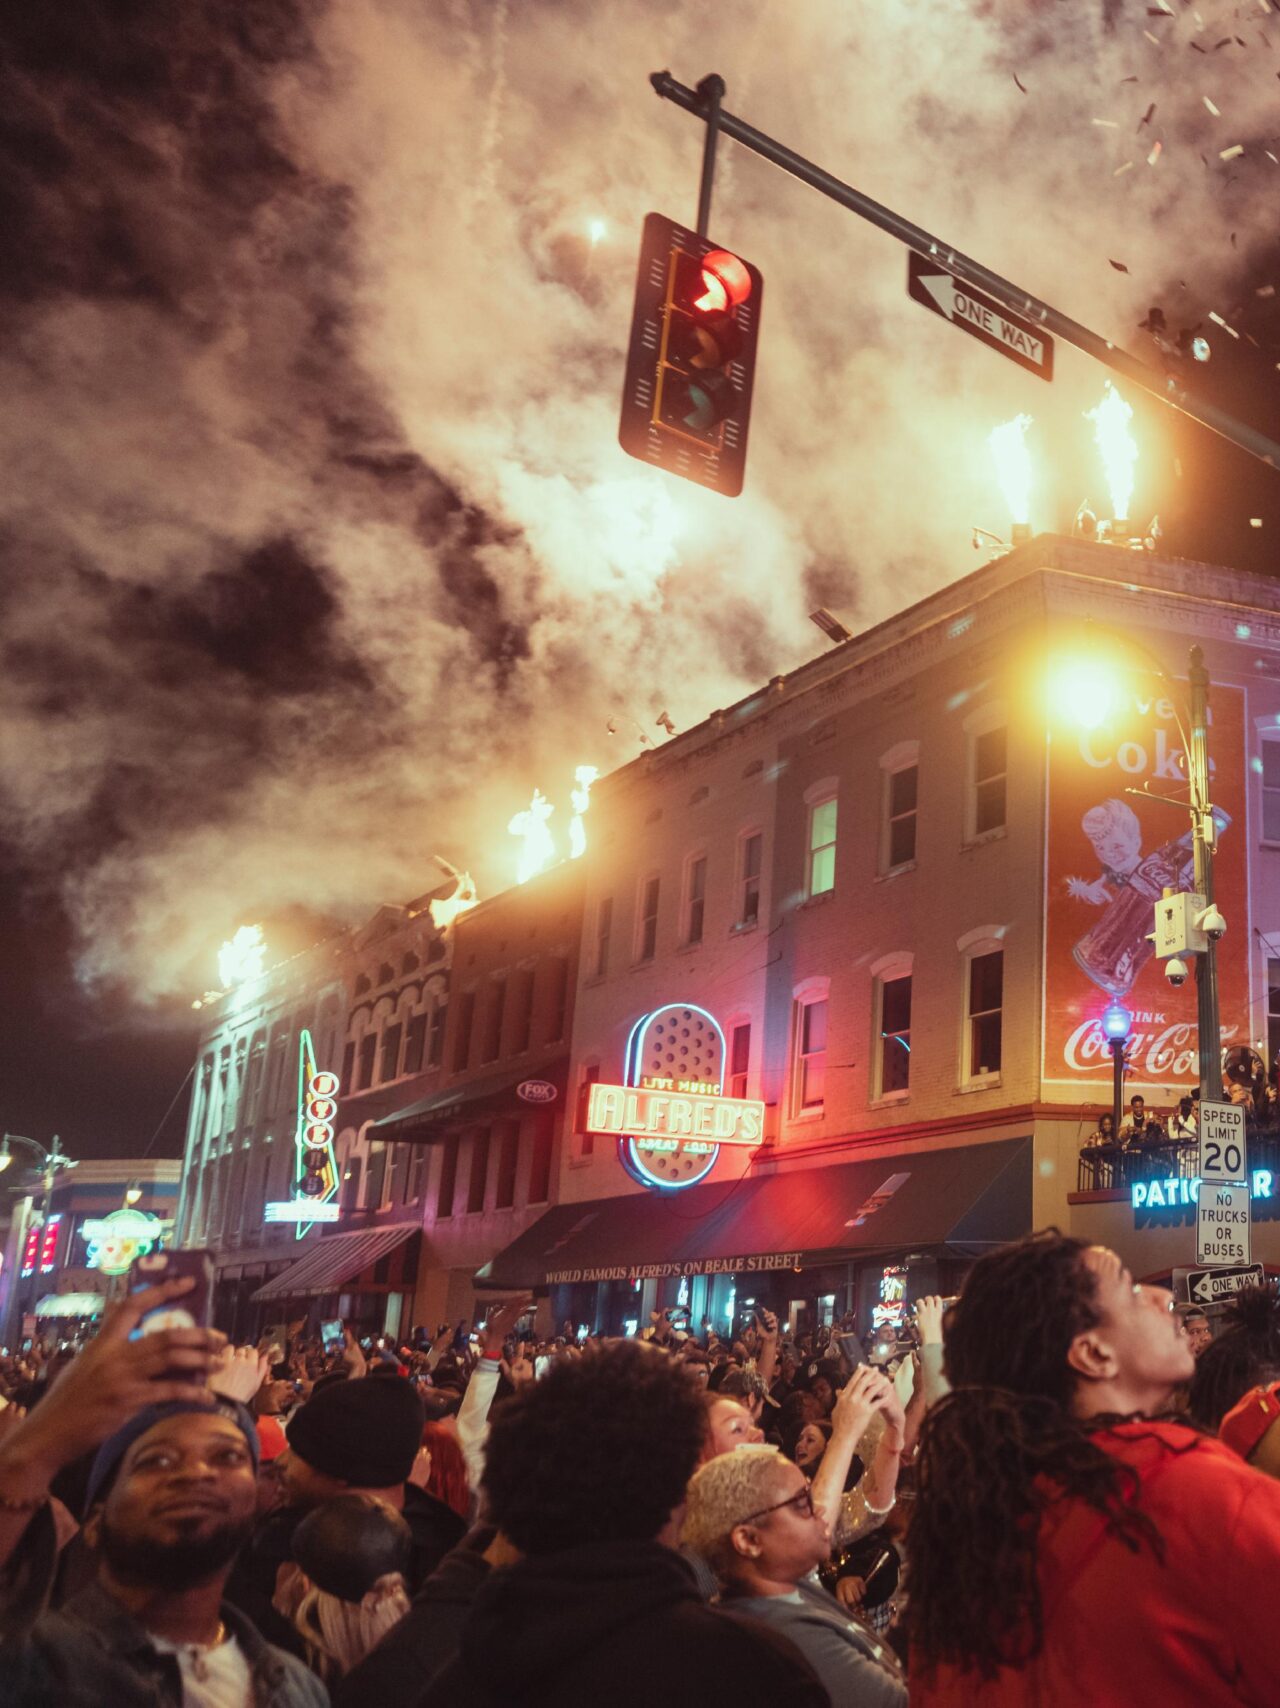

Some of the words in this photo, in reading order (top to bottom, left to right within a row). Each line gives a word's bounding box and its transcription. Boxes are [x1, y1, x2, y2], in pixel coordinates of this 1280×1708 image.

[954, 293, 993, 332] ONE
[1000, 320, 1039, 357] WAY
[1079, 726, 1216, 782] Cok
[1129, 1010, 1166, 1024] RINK
[525, 1083, 550, 1098] FOX
[678, 1080, 720, 1096] MUSIC
[594, 1086, 761, 1140] ALFRED'S
[1203, 1109, 1241, 1125] SPEED
[1207, 1126, 1237, 1141] LIMIT
[1204, 1142, 1241, 1173] 20
[1216, 1194, 1232, 1206] NO
[1201, 1209, 1247, 1224] TRUCKS
[1216, 1227, 1232, 1240] OR
[1204, 1243, 1244, 1257] BUSES
[545, 1268, 581, 1284] WORLD
[582, 1266, 627, 1281] FAMOUS
[628, 1261, 680, 1279] ALFRED'S
[683, 1260, 703, 1275] ON
[704, 1257, 744, 1274] BEALE
[746, 1253, 802, 1272] STREET
[1212, 1278, 1233, 1293] ONE
[1235, 1274, 1256, 1288] WAY
